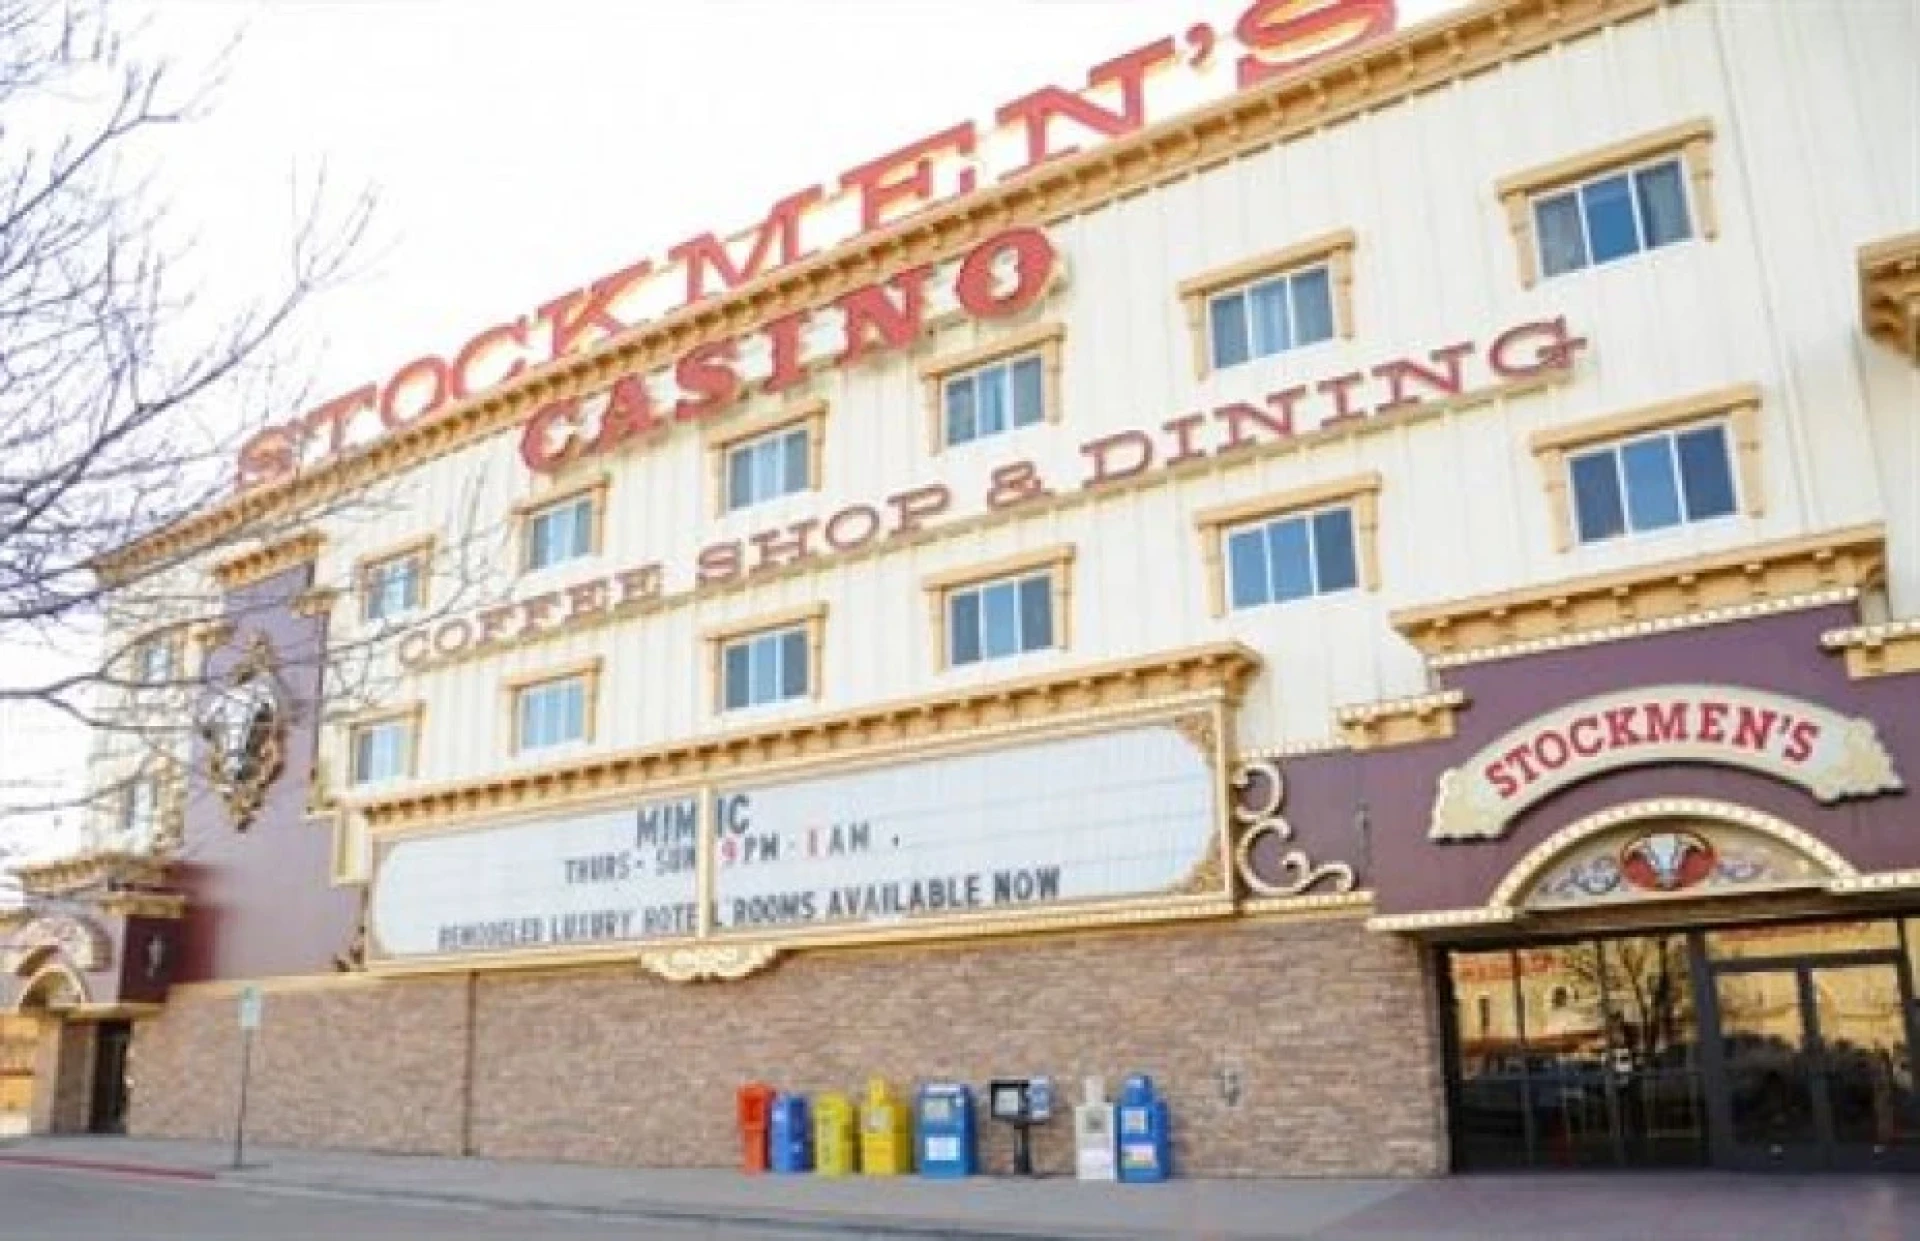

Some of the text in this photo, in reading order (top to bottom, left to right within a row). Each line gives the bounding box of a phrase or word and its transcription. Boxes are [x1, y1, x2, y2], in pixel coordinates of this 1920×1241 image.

[237, 0, 1398, 492] STOCKMEN'S
[519, 226, 1057, 473] CASINO
[397, 315, 1587, 669] COFFEE SHOP & DINING
[1485, 702, 1820, 798] STOCKMEN'S
[732, 889, 817, 925] ROOMS
[827, 873, 982, 917] AVAILABLE
[994, 865, 1061, 906] NOW
